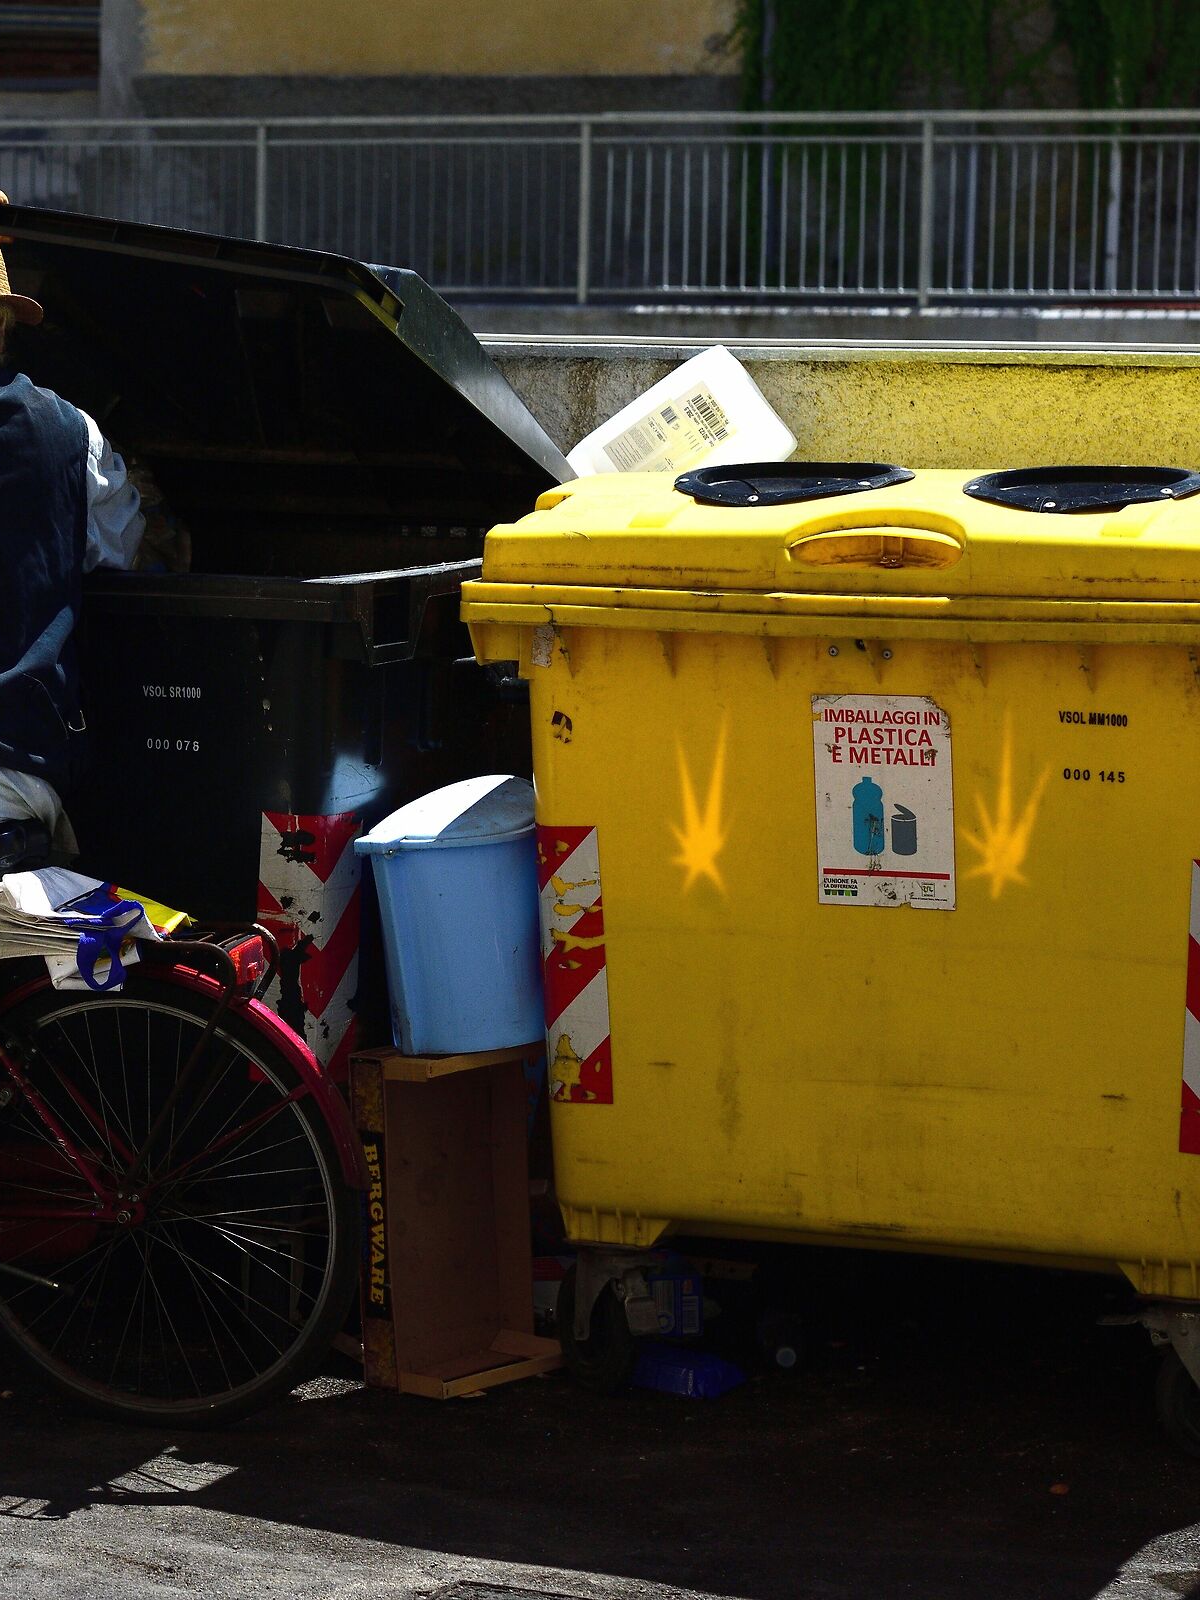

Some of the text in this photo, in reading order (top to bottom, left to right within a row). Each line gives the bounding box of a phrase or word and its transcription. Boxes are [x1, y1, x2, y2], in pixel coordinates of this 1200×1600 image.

[142, 685, 201, 699] VSOL SR1000
[824, 708, 940, 726] IMBALLAGGI IN
[1058, 710, 1128, 727] VSOL MM1000
[147, 738, 170, 750] 000
[834, 726, 933, 747] PLASTICA
[832, 746, 936, 767] E METALLI
[1063, 768, 1125, 783] 000 145
[363, 1143, 385, 1305] BERGWARE
